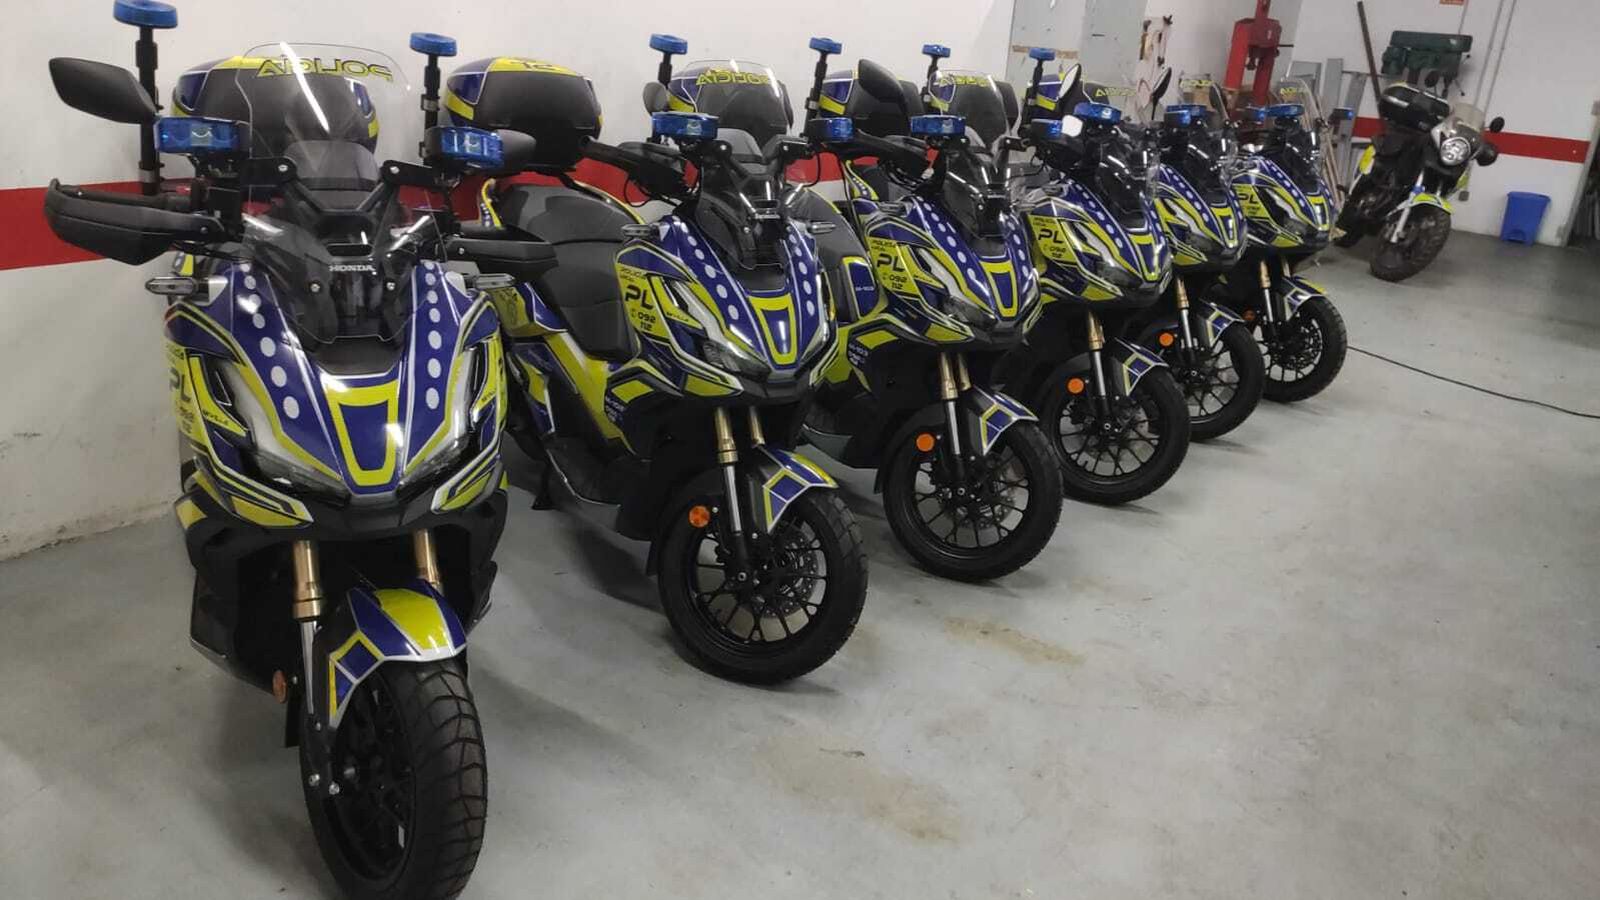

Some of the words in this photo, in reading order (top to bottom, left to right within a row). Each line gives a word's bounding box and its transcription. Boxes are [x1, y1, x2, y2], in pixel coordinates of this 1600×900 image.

[1037, 228, 1064, 245] PL
[876, 253, 906, 272] PL
[625, 284, 653, 310] PL
[637, 311, 656, 323] 092
